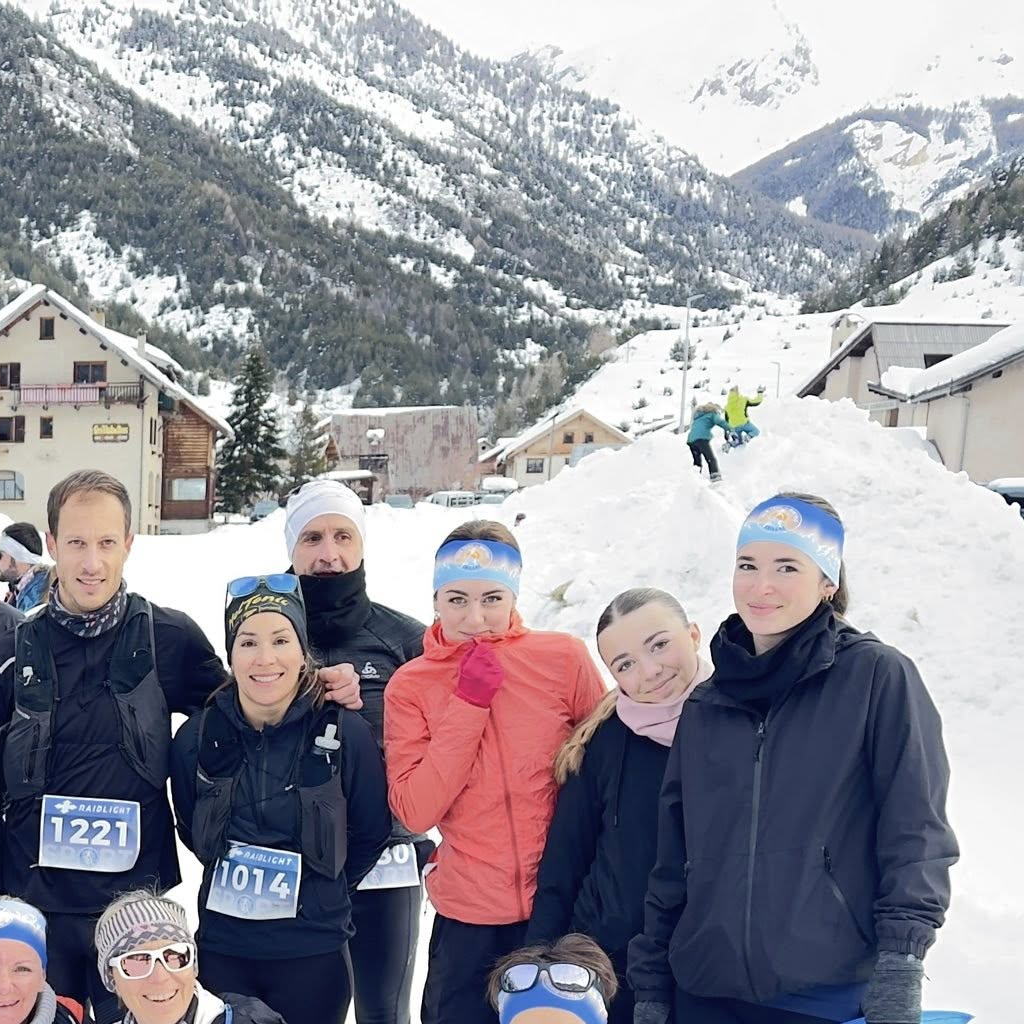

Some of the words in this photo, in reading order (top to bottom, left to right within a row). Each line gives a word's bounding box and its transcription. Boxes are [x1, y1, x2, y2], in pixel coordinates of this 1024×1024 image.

[78, 804, 131, 815] RAIDLIGHT
[51, 816, 128, 848] 1221
[243, 851, 292, 866] RAIDLIGHT
[220, 860, 291, 900] 1014
